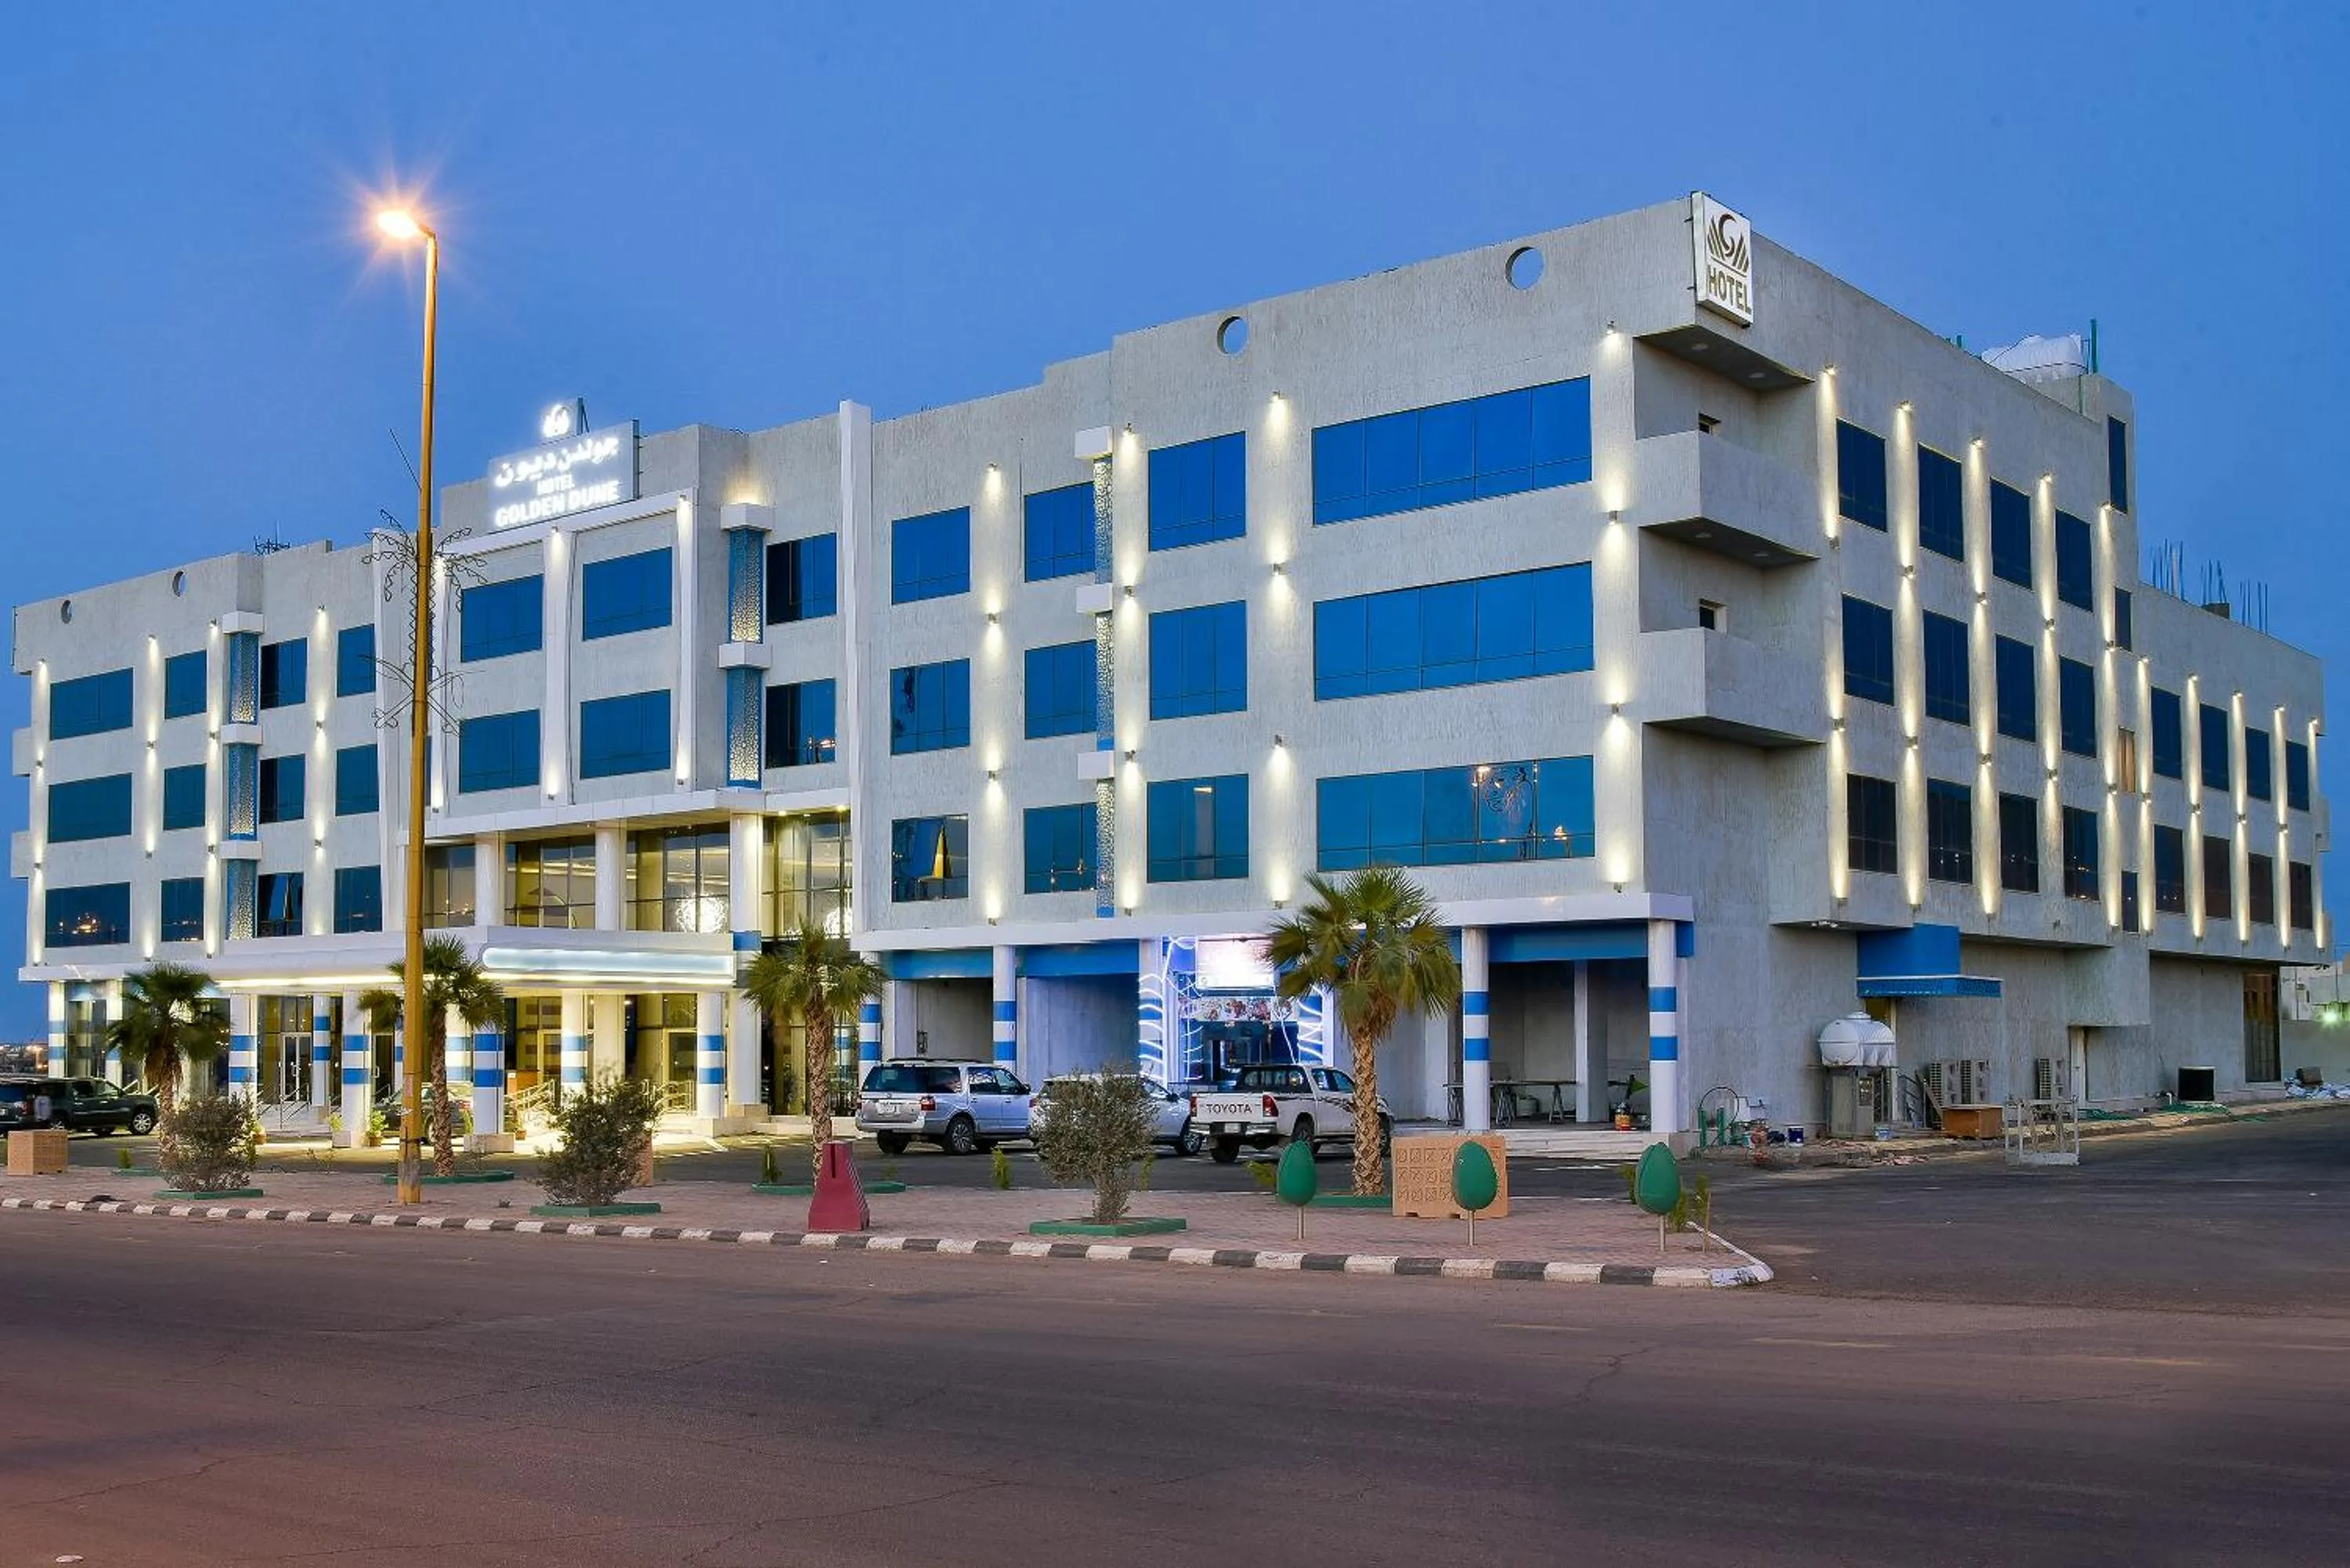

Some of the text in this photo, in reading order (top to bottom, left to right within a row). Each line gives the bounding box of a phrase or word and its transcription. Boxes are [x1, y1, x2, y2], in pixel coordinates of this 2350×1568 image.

[1708, 264, 1752, 315] HOTEL
[537, 474, 575, 495] HOTEL
[495, 481, 620, 527] GOLDEN DUNE
[1206, 1103, 1253, 1115] TOYOTA
